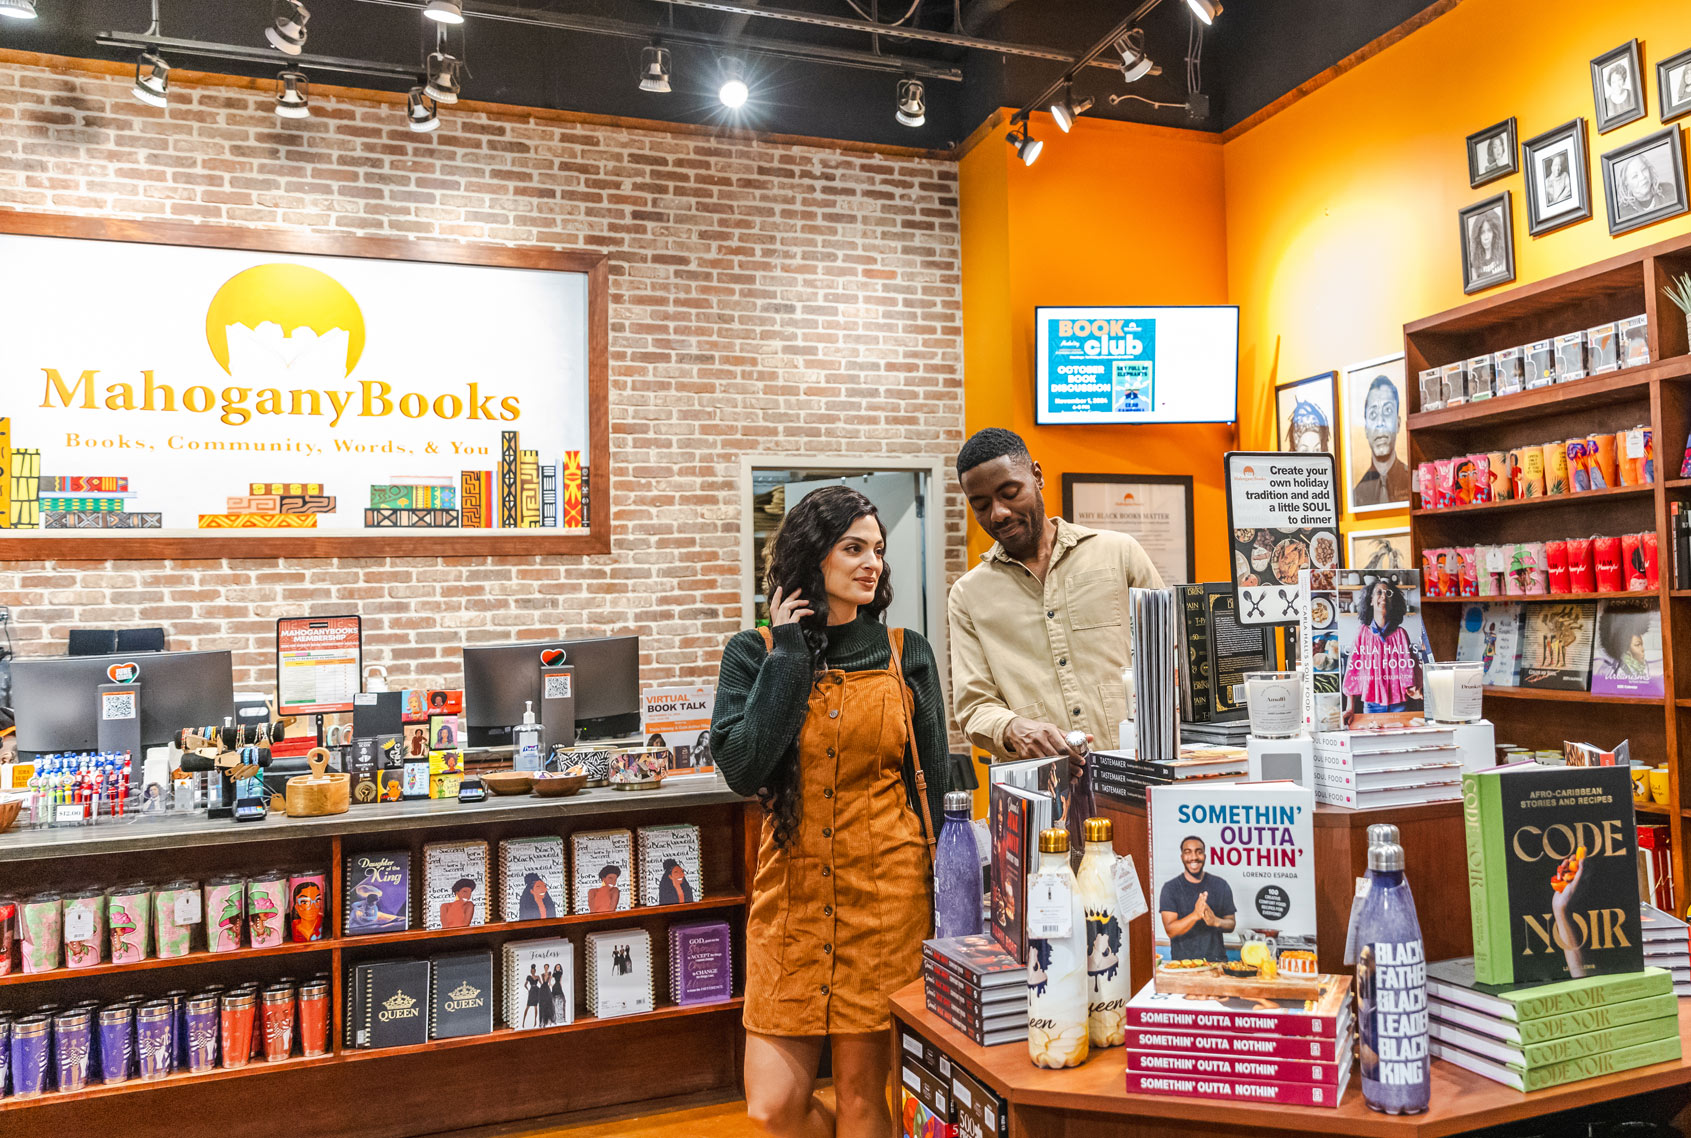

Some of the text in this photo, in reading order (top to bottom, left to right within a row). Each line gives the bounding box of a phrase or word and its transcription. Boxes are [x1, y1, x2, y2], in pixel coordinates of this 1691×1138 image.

[1058, 320, 1124, 337] BOOK
[1084, 334, 1143, 356] club
[1068, 374, 1096, 383] BOOK
[38, 367, 521, 429] MahoganyBooks
[64, 432, 490, 456] Books, Community, Words, & You
[1270, 466, 1328, 477] Create your
[1294, 478, 1329, 489] holiday
[1246, 490, 1330, 500] tradition and add
[1278, 502, 1300, 512] little
[1302, 502, 1331, 512] SOUL
[1288, 515, 1332, 524] to dinner
[281, 628, 358, 637] MAHOGANYBOOKS
[1344, 644, 1419, 656] CARLA HALL'S
[1348, 659, 1416, 670] SOUL FOOD
[646, 694, 690, 704] VIRTUAL
[648, 702, 707, 712] BOOK TALK
[1100, 757, 1126, 768] TASTEMAKER
[1100, 771, 1126, 782] TASTEMAKER
[1314, 772, 1342, 783] SOUL FOOD
[1101, 784, 1126, 796] TASTEMAKER
[1315, 790, 1344, 801] SOUL FOOD
[1530, 787, 1603, 799] AFRO-CARIBBEAN
[1520, 799, 1557, 808] STORIES
[1578, 795, 1613, 804] RECIPES
[1178, 804, 1302, 825] SOMETHIN'
[1220, 826, 1295, 846] OUTTA
[1512, 820, 1627, 863] CODE
[358, 858, 394, 869] Daughter
[1210, 847, 1303, 867] NOTHIN'
[365, 868, 402, 885] King
[1522, 908, 1632, 955] NOIR
[529, 950, 560, 960] Fearless
[1375, 939, 1424, 966] BLACK
[444, 998, 484, 1012] QUEEN
[1377, 986, 1427, 1013] BLACK
[1521, 986, 1606, 1017] CODE NOIR
[378, 1008, 420, 1022] QUEEN
[1140, 1012, 1279, 1029] SOMETHIN' OUTTA NOTHIN'
[1526, 1008, 1611, 1040] CODE NOIR
[1139, 1034, 1277, 1052] SOMETHIN' OUTTA NOTHIN'
[1378, 1035, 1428, 1061] BLACK
[1530, 1032, 1612, 1064] CODE NOIR
[1140, 1056, 1279, 1075] SOMETHIN' OUTTA NOTHIN'
[1379, 1060, 1423, 1085] KING
[1528, 1054, 1614, 1087] CODE NOIR
[1140, 1078, 1279, 1098] SOMETHIN' OUTTA NOTHIN'
[960, 1110, 975, 1137] 500
